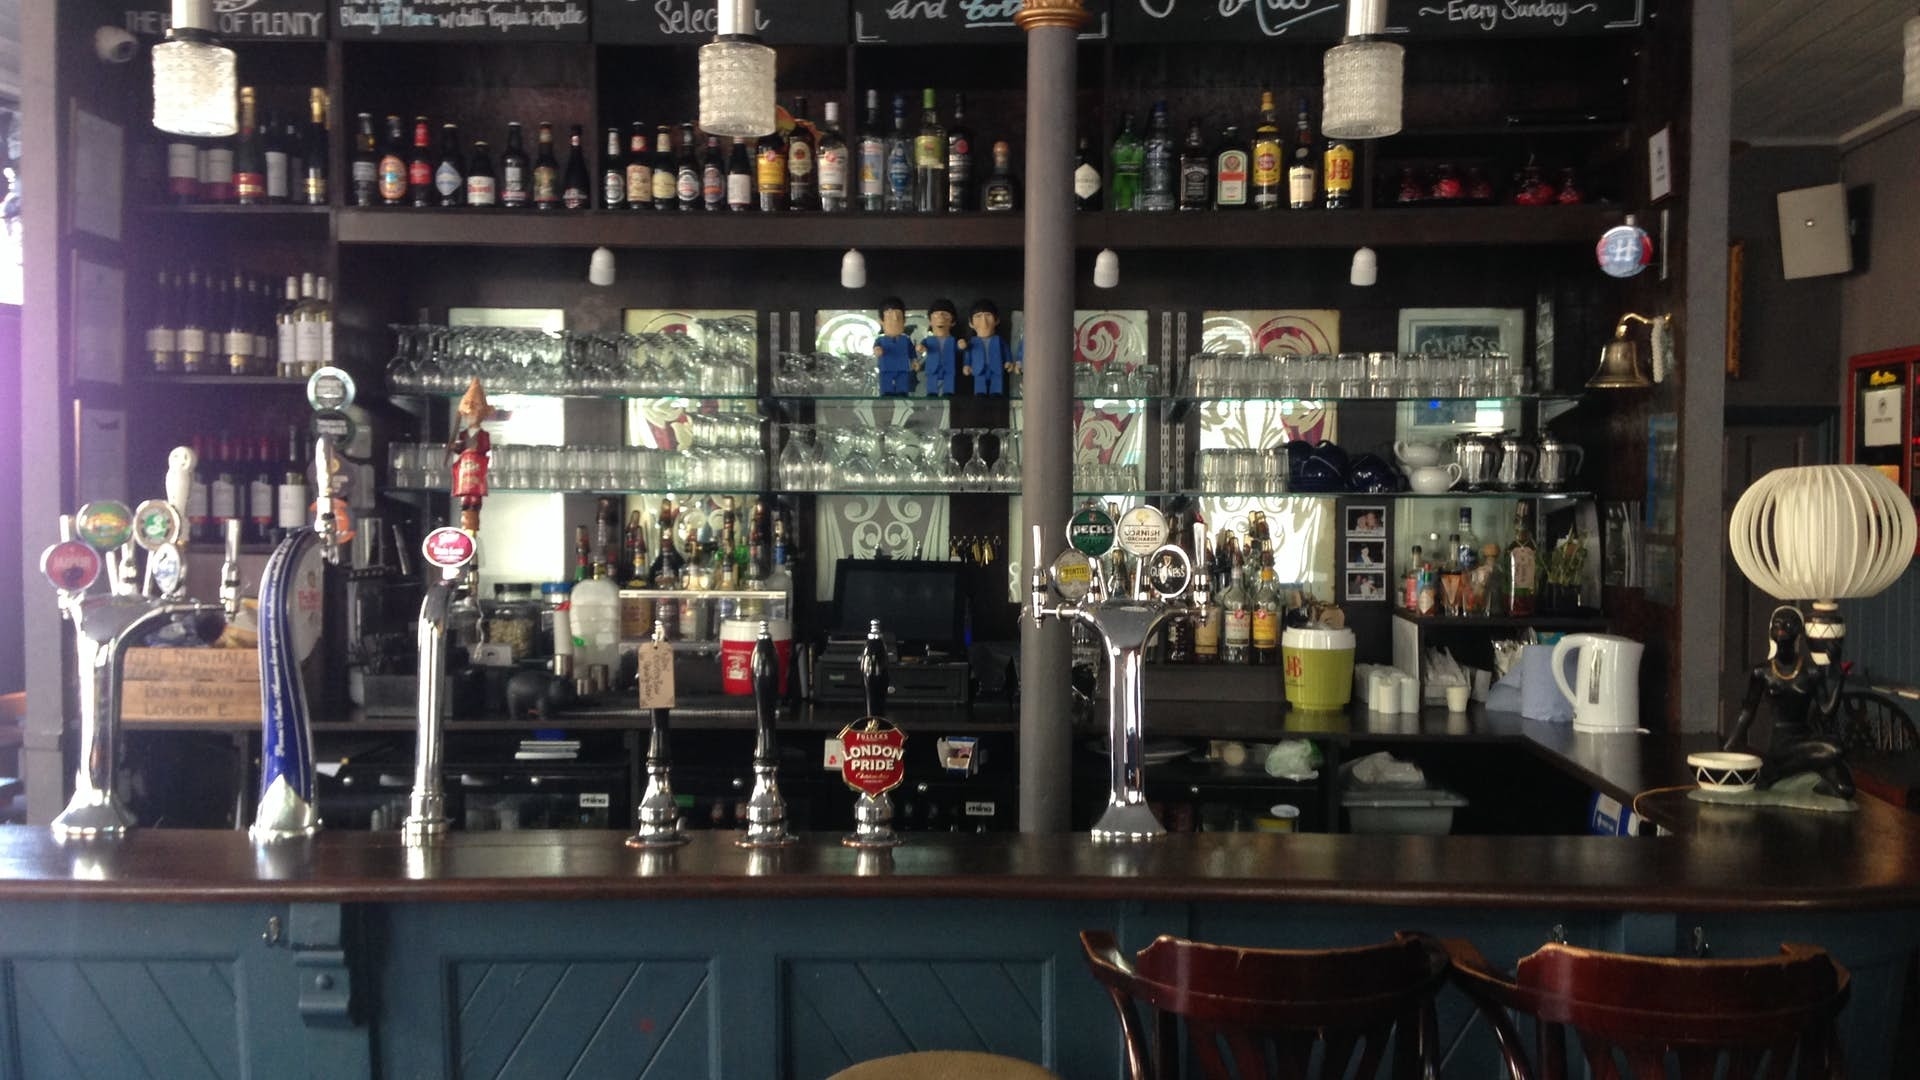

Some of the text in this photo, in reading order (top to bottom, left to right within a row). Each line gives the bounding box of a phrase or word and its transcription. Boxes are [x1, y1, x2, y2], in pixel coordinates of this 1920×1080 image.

[219, 12, 324, 36] OF PLENTY
[655, 0, 770, 34] Selecn
[1448, 0, 1570, 30] Every Sunday
[1150, 566, 1186, 577] GUNESS
[842, 744, 904, 761] LONDON
[851, 759, 895, 771] PRIDE
